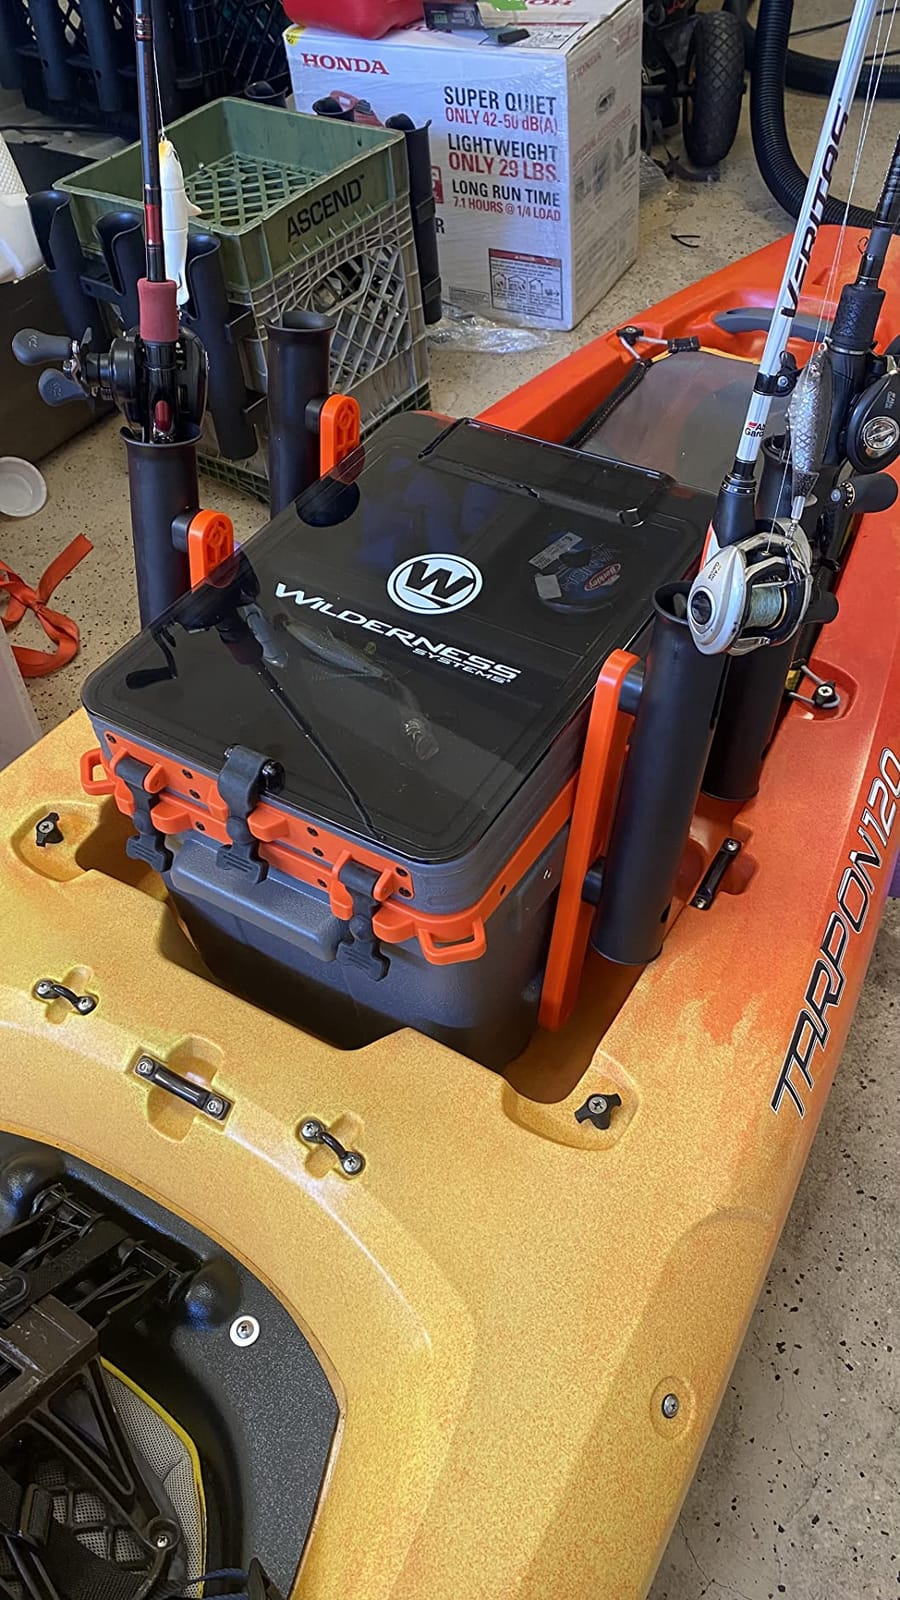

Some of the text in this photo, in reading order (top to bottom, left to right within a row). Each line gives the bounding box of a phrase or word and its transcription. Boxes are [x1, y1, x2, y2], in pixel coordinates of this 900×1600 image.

[301, 53, 389, 75] HONDA
[444, 86, 557, 116] SUPER QUIET
[445, 107, 558, 136] ONLY 42-50 dB(A)
[448, 133, 558, 163] LIGHTWEIGHT
[449, 151, 561, 183] ONLY 29 LBS.
[452, 179, 489, 199] LONG
[493, 184, 521, 203] RUN
[525, 189, 561, 208] TIME
[453, 196, 561, 222] 7.1 HOURS @ 1/4 LOAD
[770, 746, 900, 1120] TARPON 120
